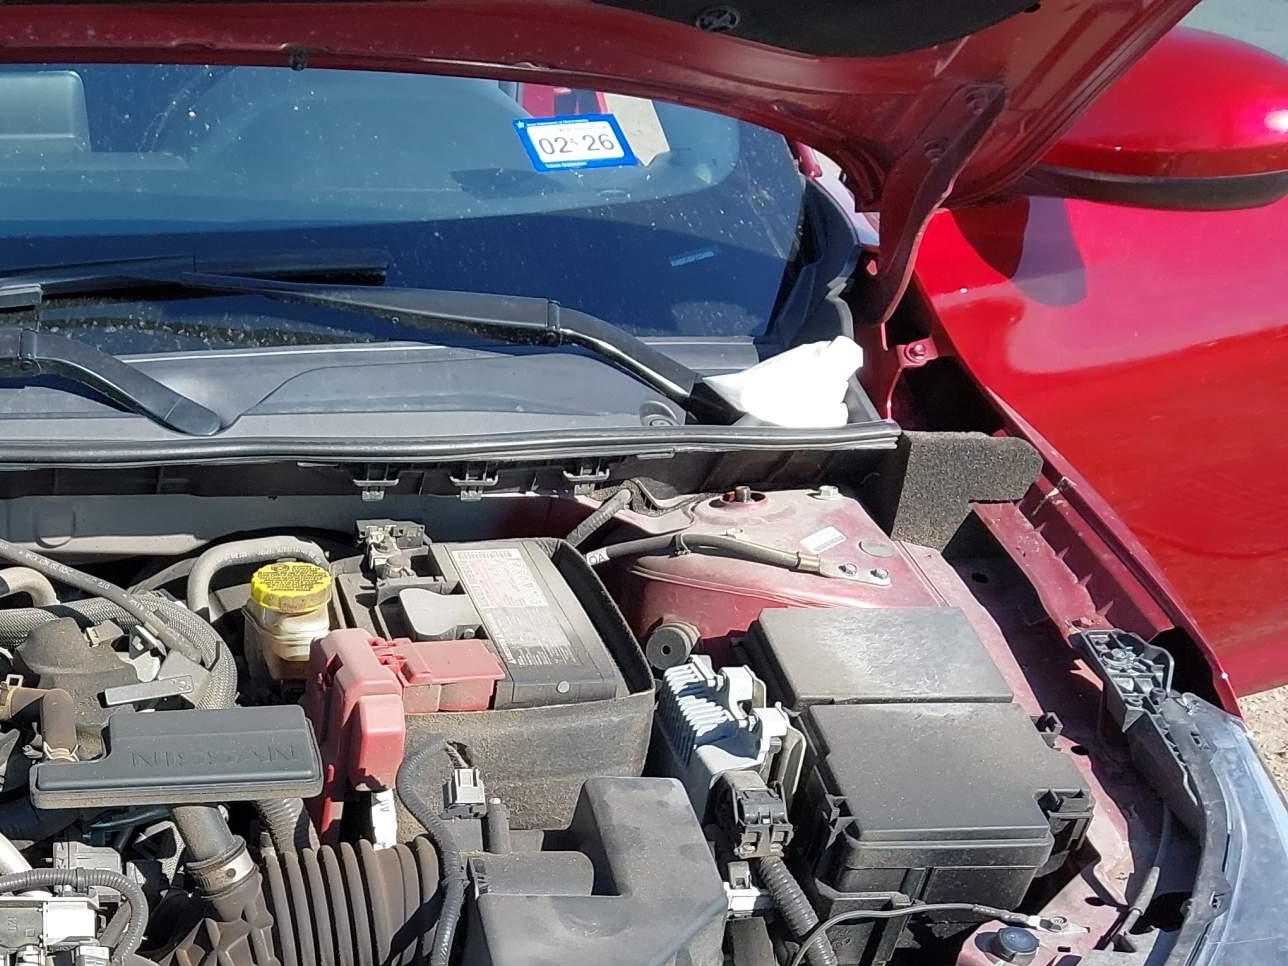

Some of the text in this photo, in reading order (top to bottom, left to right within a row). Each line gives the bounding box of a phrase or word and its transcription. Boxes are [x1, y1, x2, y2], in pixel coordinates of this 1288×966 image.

[538, 133, 615, 155] 02 26
[131, 744, 296, 769] NISSAN
